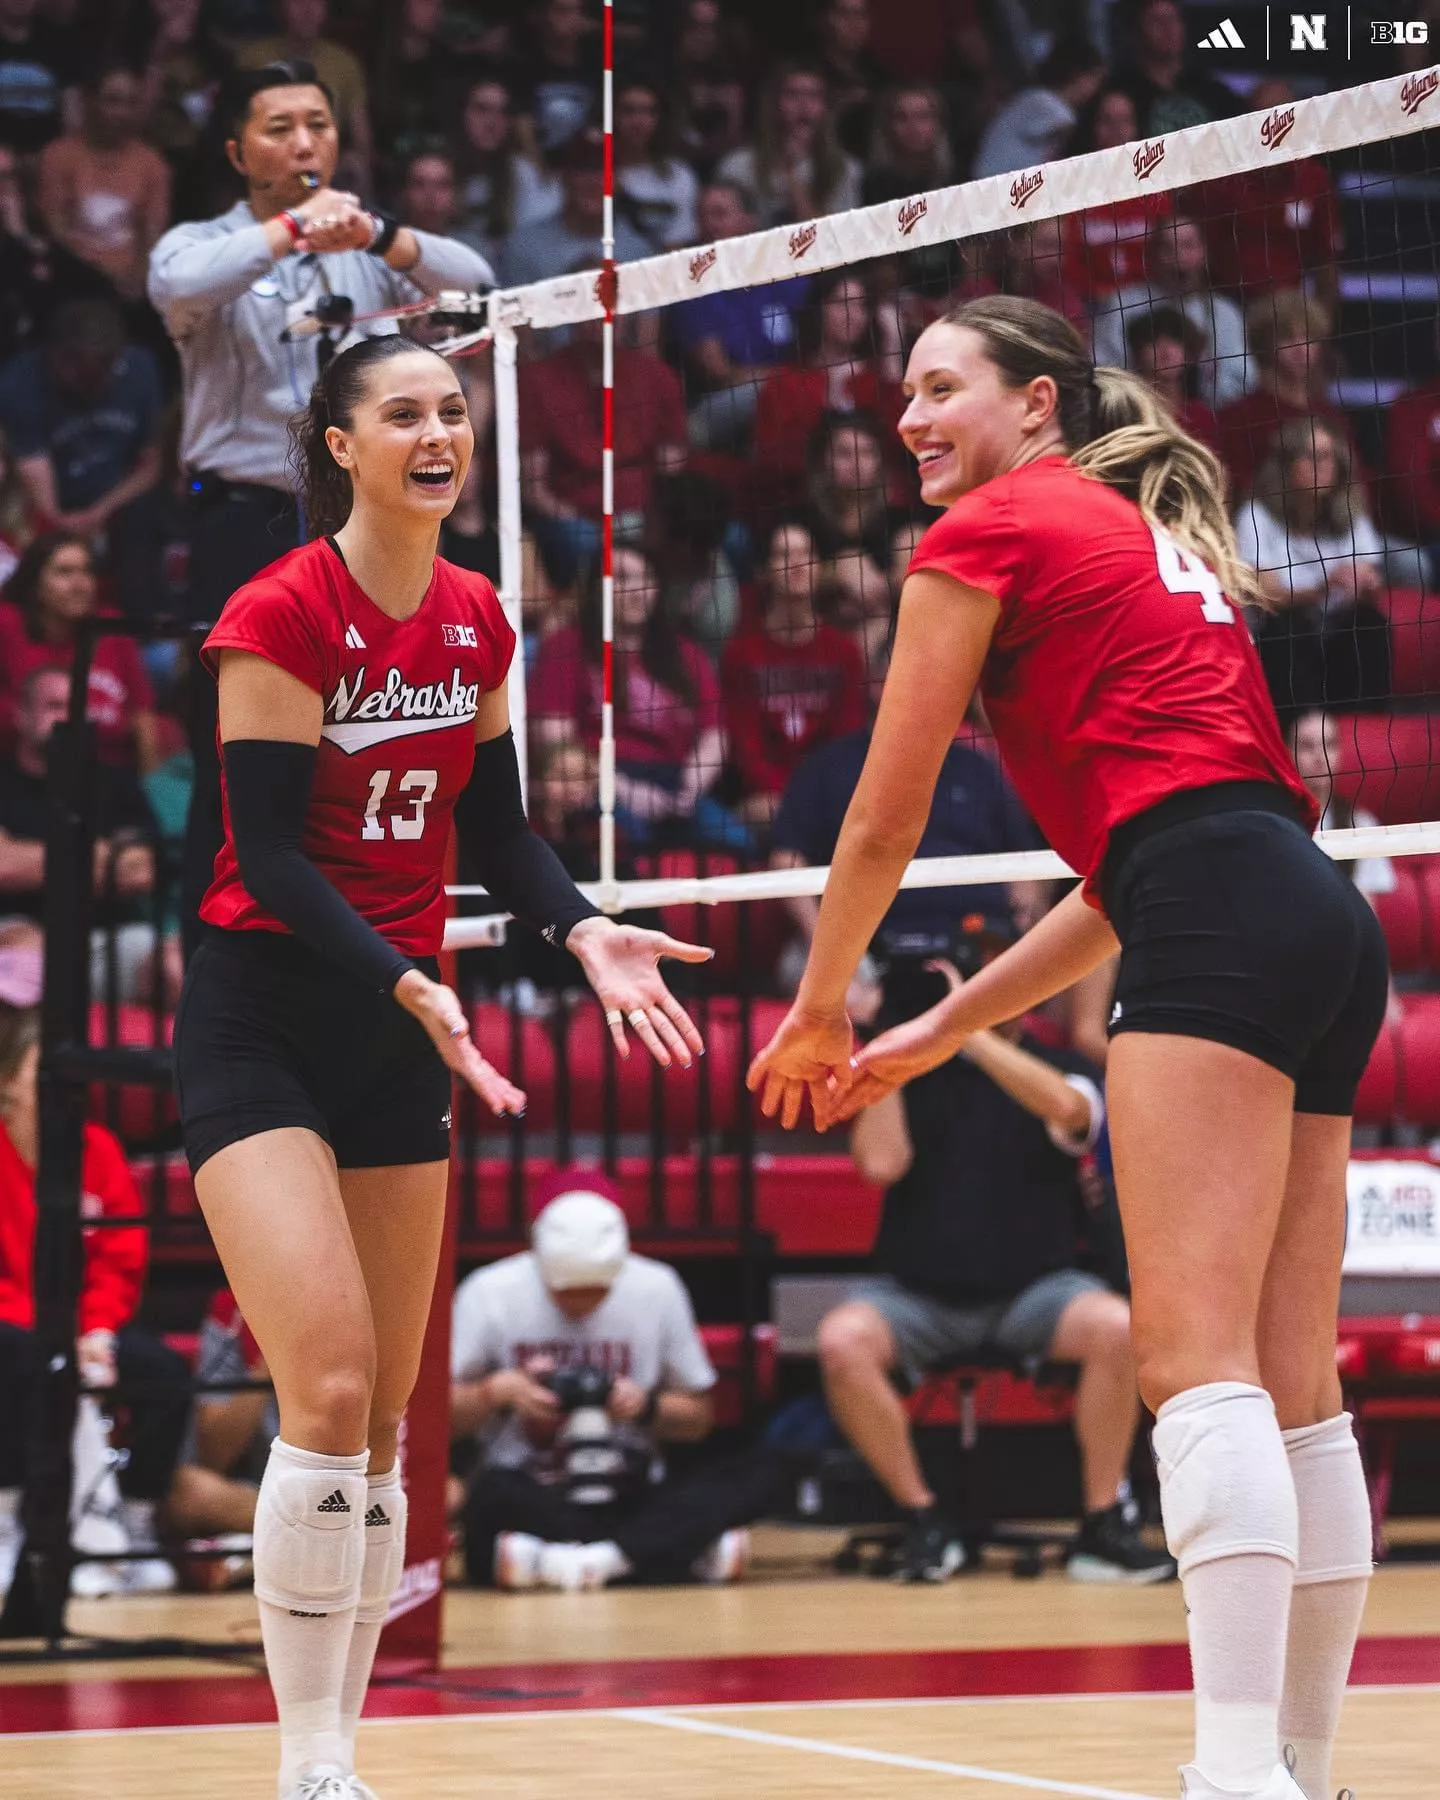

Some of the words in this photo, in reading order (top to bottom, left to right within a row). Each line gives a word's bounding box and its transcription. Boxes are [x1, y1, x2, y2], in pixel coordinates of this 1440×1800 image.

[1261, 107, 1295, 148] Indiana
[1010, 170, 1044, 207] Indiana
[1152, 528, 1235, 624] 4
[325, 666, 479, 722] Nebraska
[361, 770, 438, 840] 13
[317, 1503, 351, 1513] adidas
[365, 1516, 391, 1527] didas
